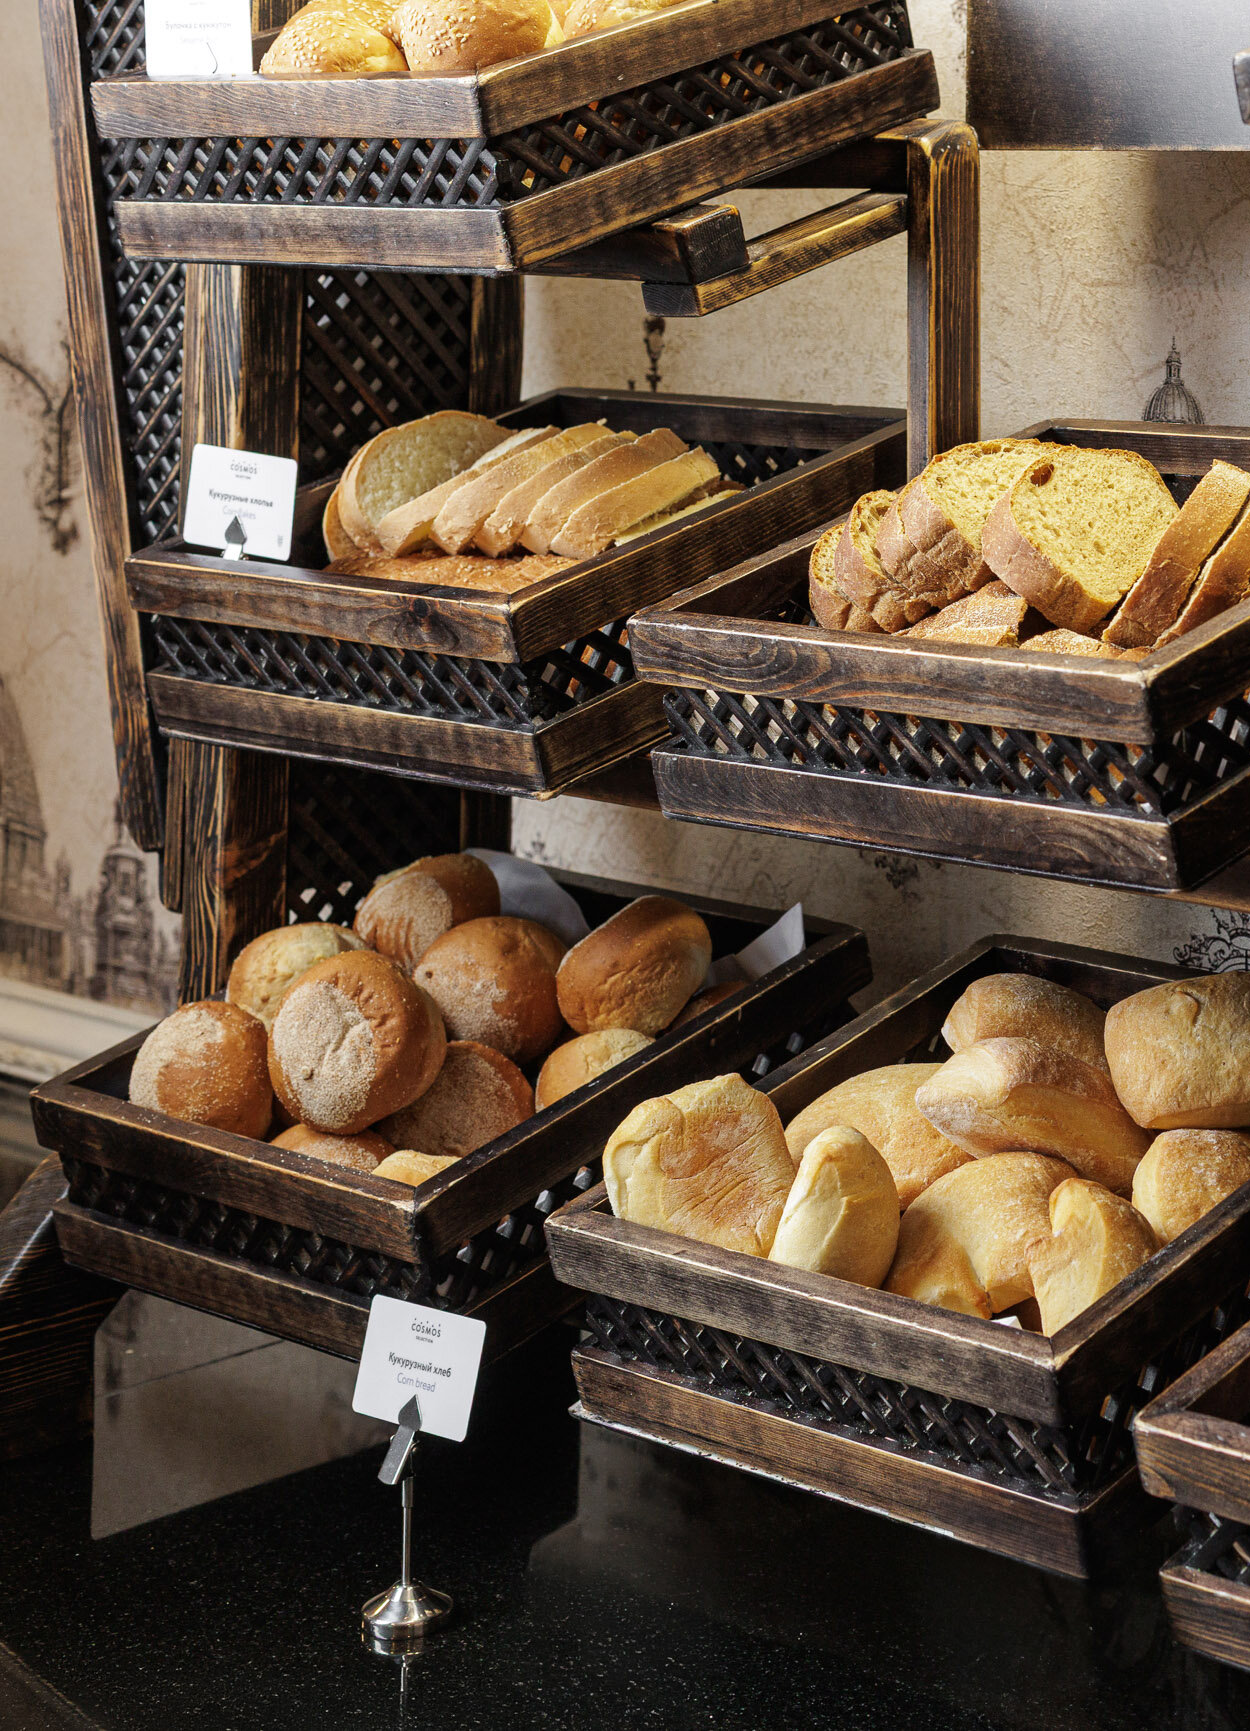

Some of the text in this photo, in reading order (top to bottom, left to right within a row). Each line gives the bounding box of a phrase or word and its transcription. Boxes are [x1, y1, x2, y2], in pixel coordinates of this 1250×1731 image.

[230, 463, 258, 474] COSMOS
[208, 488, 248, 502] Кукурузные
[411, 1322, 441, 1337] COSMOS
[388, 1352, 452, 1377] Кукурузный хлеб
[396, 1372, 436, 1392] Corn bread
